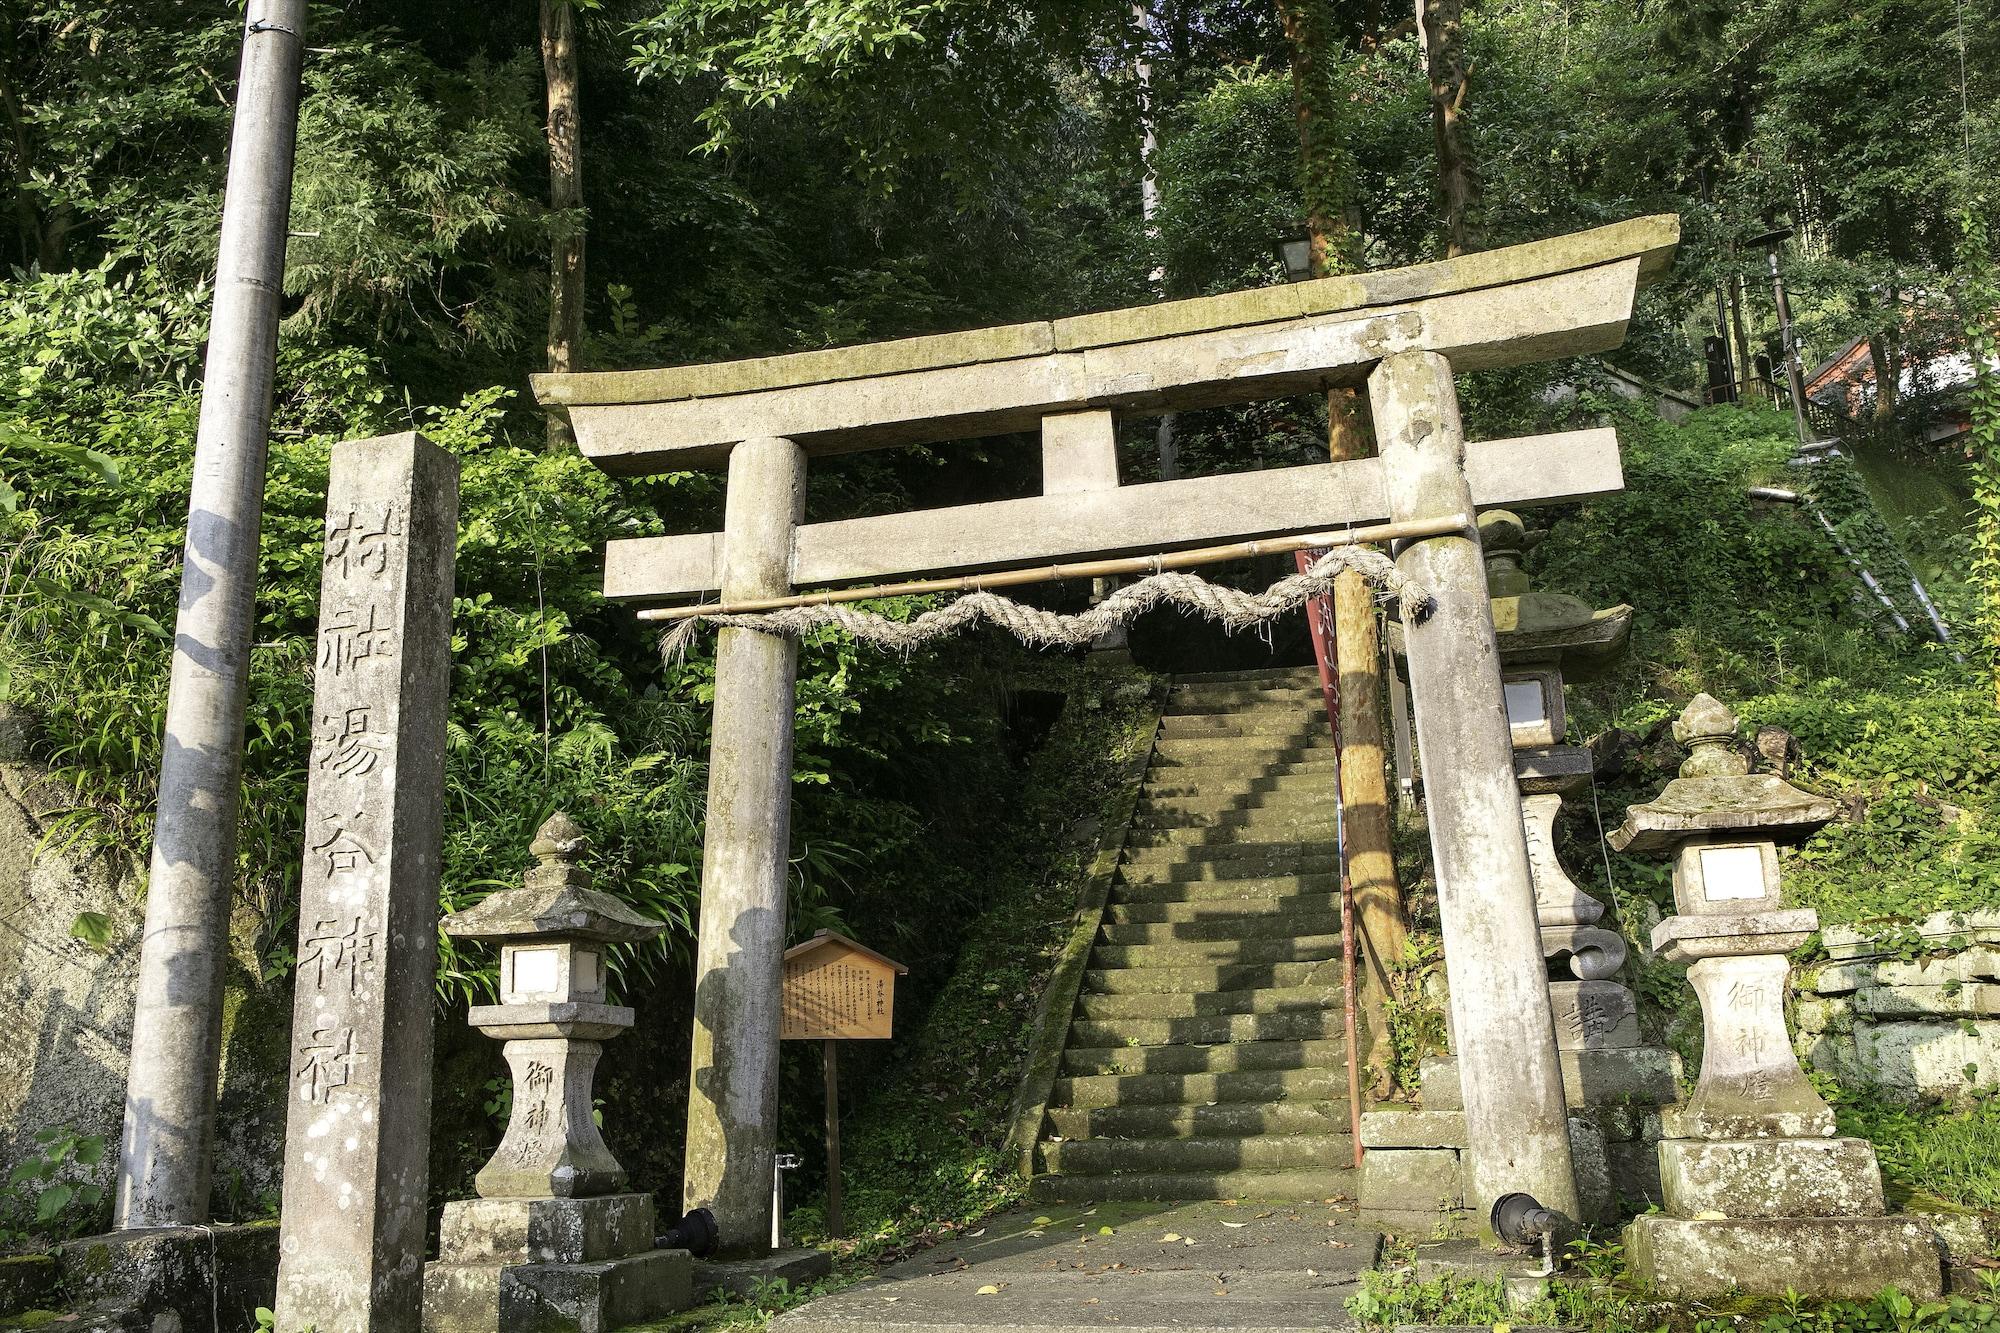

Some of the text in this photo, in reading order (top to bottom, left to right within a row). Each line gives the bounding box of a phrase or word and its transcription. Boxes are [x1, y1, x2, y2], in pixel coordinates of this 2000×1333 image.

[296, 508, 402, 1104] 村社湯谷神社
[1562, 995, 1608, 1046] 講
[1727, 981, 1777, 1101] 御神燈
